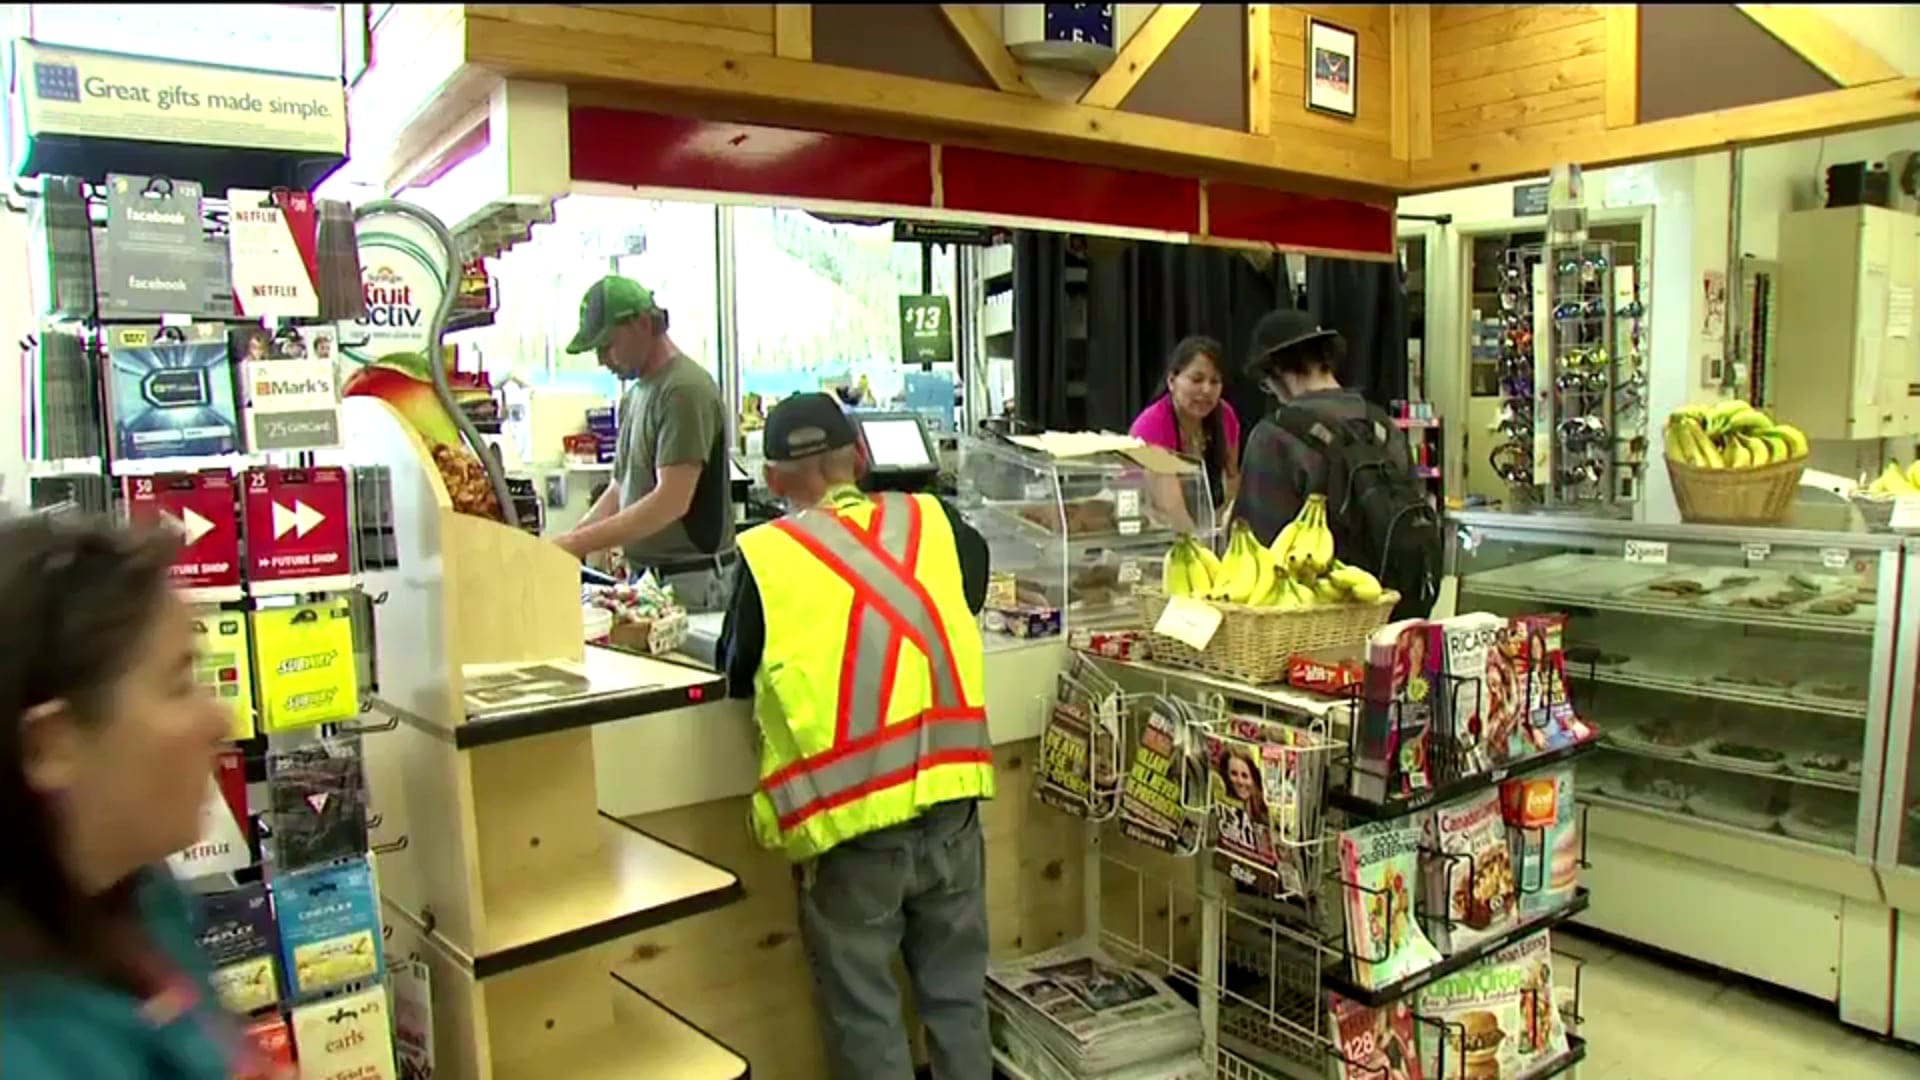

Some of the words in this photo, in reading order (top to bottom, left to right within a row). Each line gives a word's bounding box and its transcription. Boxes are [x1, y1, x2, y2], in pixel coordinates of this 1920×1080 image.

[85, 76, 150, 102] Great
[157, 86, 200, 111] gifts
[207, 92, 263, 113] made
[269, 97, 332, 120] simple.
[127, 207, 185, 225] facebook
[236, 210, 278, 224] NETFLIX
[129, 275, 187, 291] facebook
[252, 284, 298, 298] NETFLIX
[363, 283, 411, 306] fruit
[905, 306, 941, 331] $13
[271, 378, 330, 395] Mark's
[250, 472, 266, 487] 25
[271, 554, 310, 567] FUTURE
[312, 552, 339, 564] SHOP
[201, 562, 230, 575] SHOP
[183, 843, 230, 861] NETFLIX
[1343, 1030, 1374, 1061] 128
